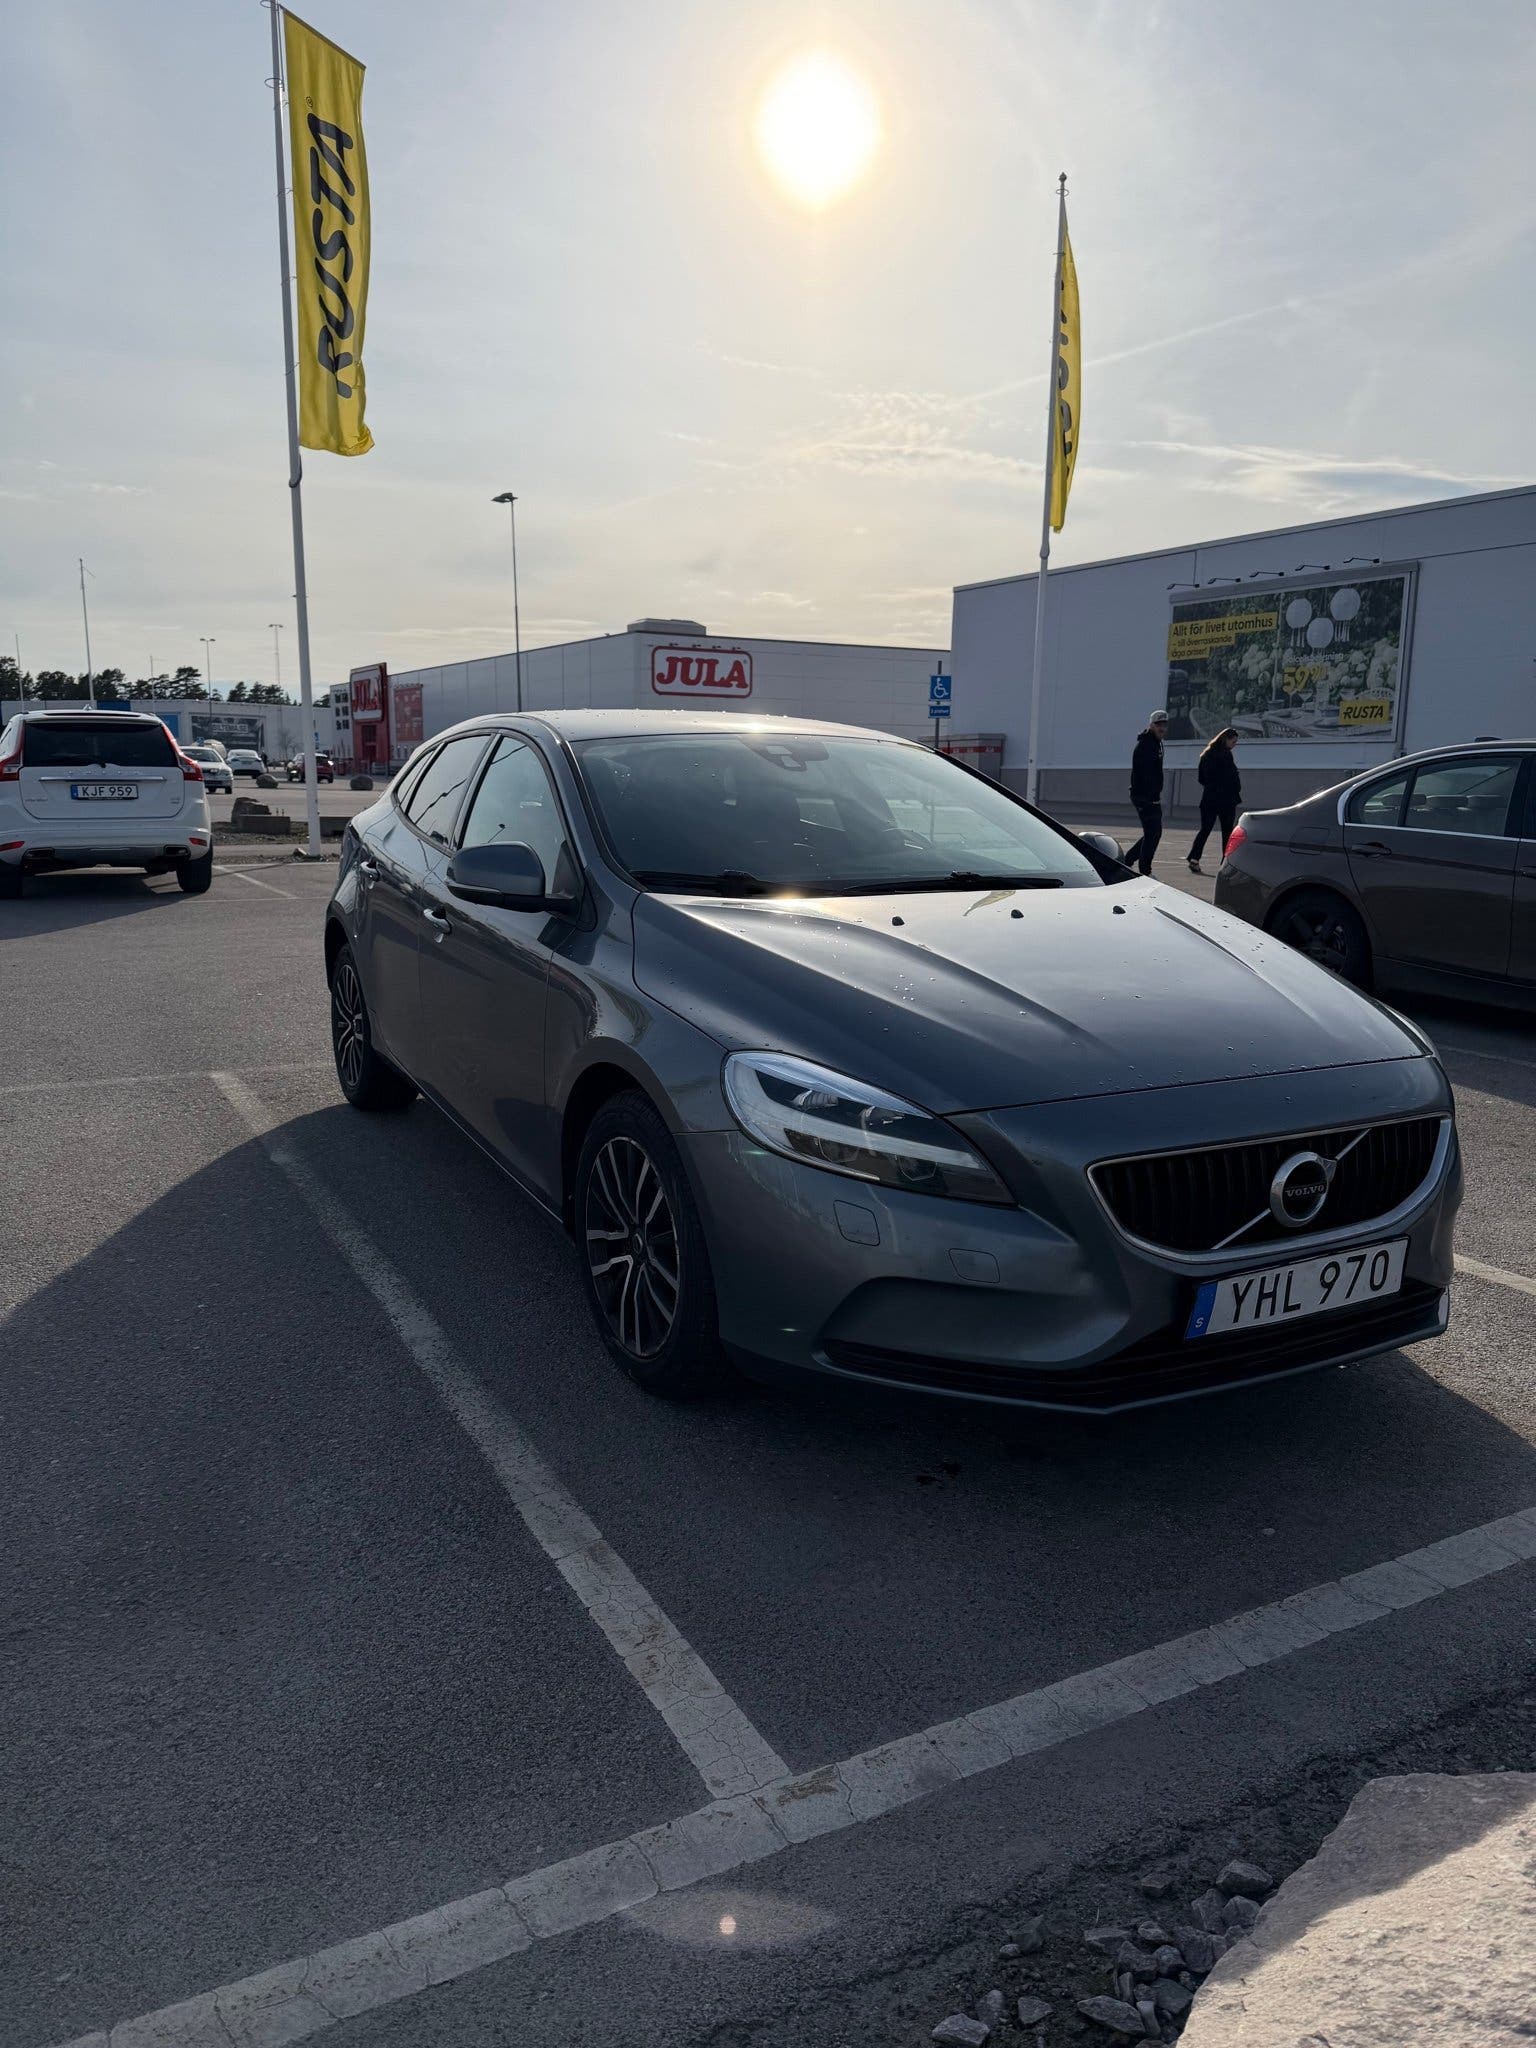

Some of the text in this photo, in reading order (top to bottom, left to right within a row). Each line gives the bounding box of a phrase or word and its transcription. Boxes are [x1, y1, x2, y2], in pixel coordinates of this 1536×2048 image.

[307, 113, 355, 398] RUSTA
[1173, 617, 1273, 637] Allt för livet utomhus
[656, 656, 749, 689] JULA
[352, 677, 382, 713] JULA
[1343, 706, 1384, 720] RUSTA
[82, 786, 133, 797] KJF 959
[1285, 1184, 1325, 1197] VOLVO
[1232, 1249, 1390, 1323] YHL 970
[1195, 1317, 1204, 1329] S
